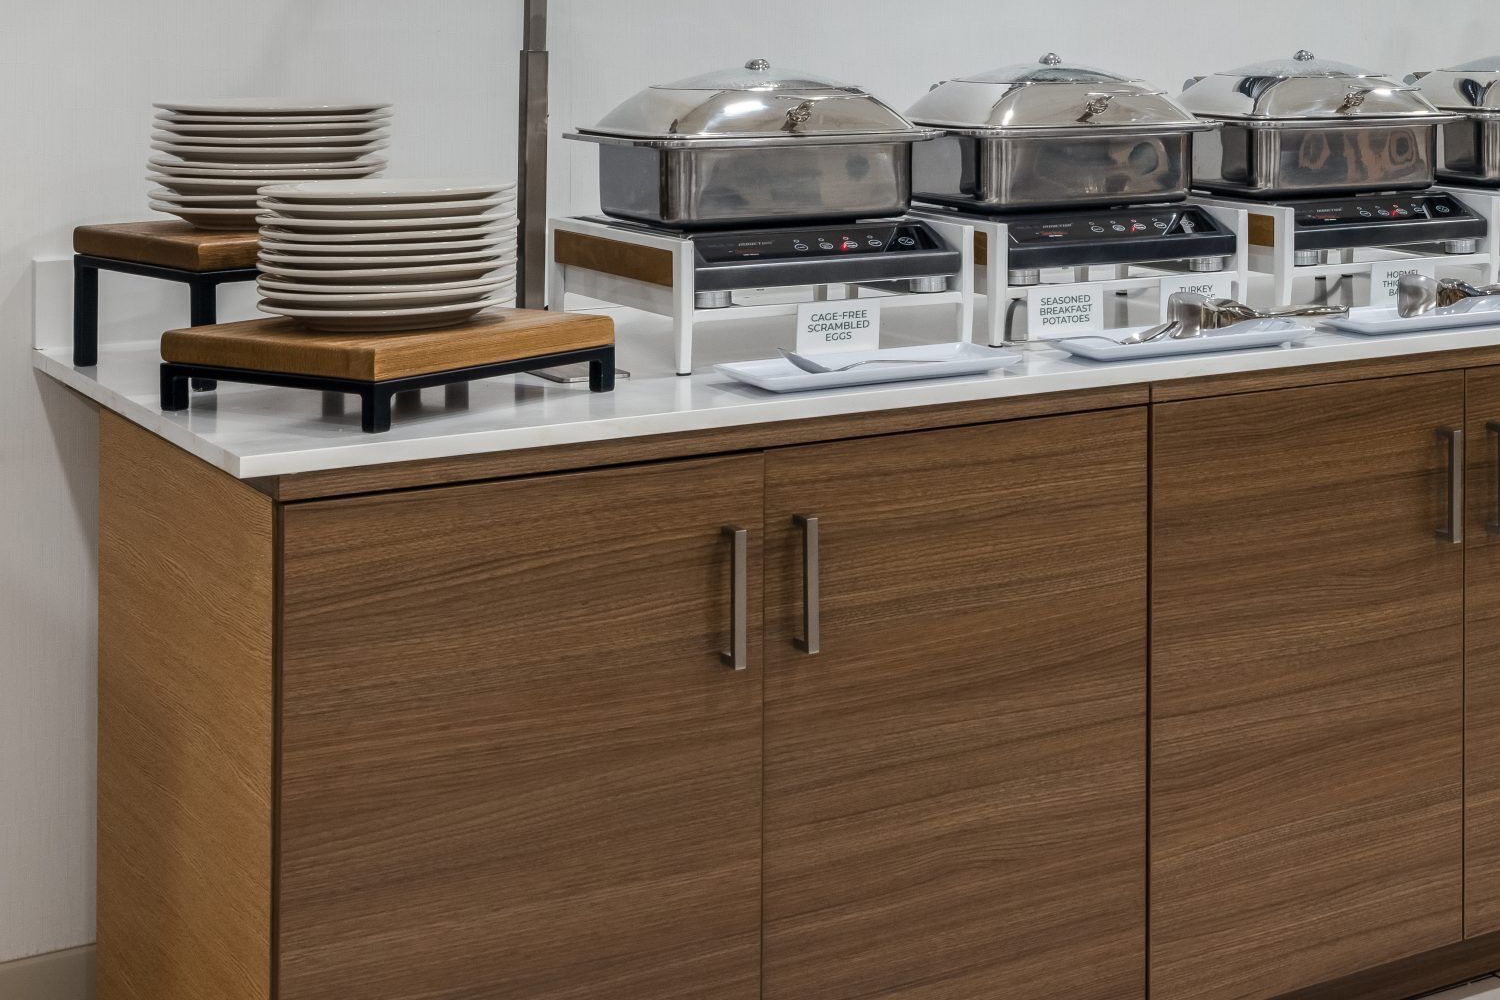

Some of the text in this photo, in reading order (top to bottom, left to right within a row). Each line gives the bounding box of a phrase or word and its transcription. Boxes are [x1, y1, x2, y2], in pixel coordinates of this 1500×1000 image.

[1040, 294, 1091, 306] SEASONED
[1040, 304, 1092, 315] BREAKFAST
[811, 310, 868, 322] CAGE-FREE
[1043, 314, 1090, 325] POTATOES
[808, 320, 870, 332] SCRAMBLED
[826, 332, 852, 341] EGGS
